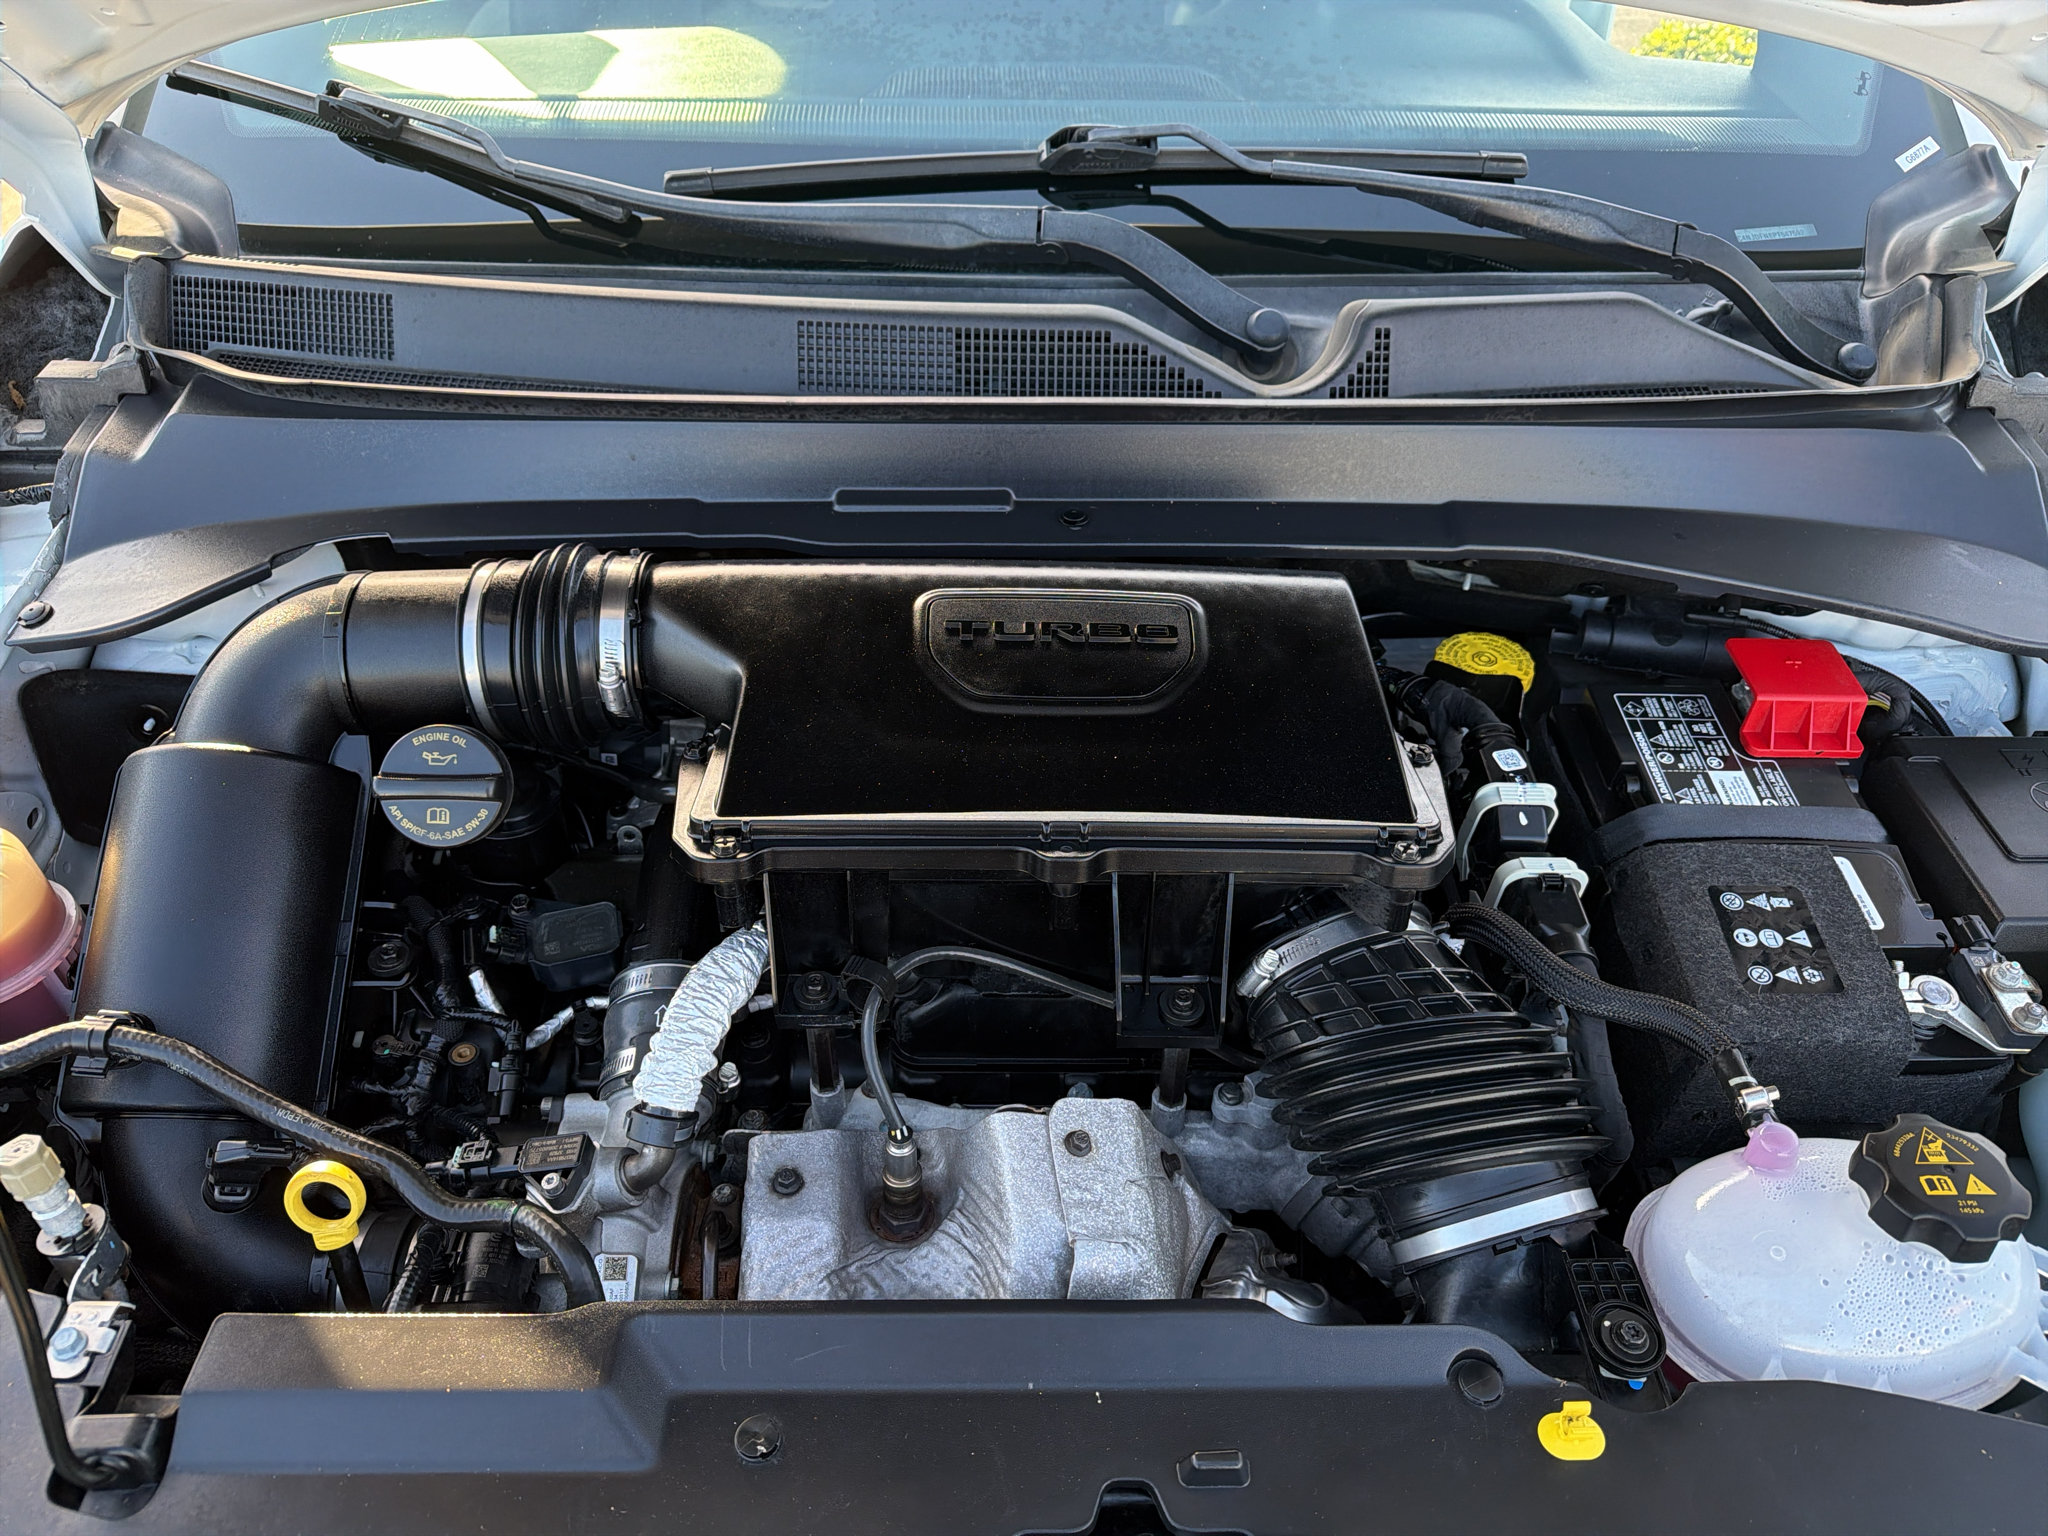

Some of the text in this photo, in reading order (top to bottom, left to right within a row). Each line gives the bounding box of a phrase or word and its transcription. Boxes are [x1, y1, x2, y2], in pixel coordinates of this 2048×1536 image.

[944, 620, 1179, 644] TURBO
[412, 732, 468, 748] ENGINE OIL
[1634, 731, 1669, 794] DANGER/POISON
[388, 805, 489, 840] API SP/GF-6A-SAE 5W-30
